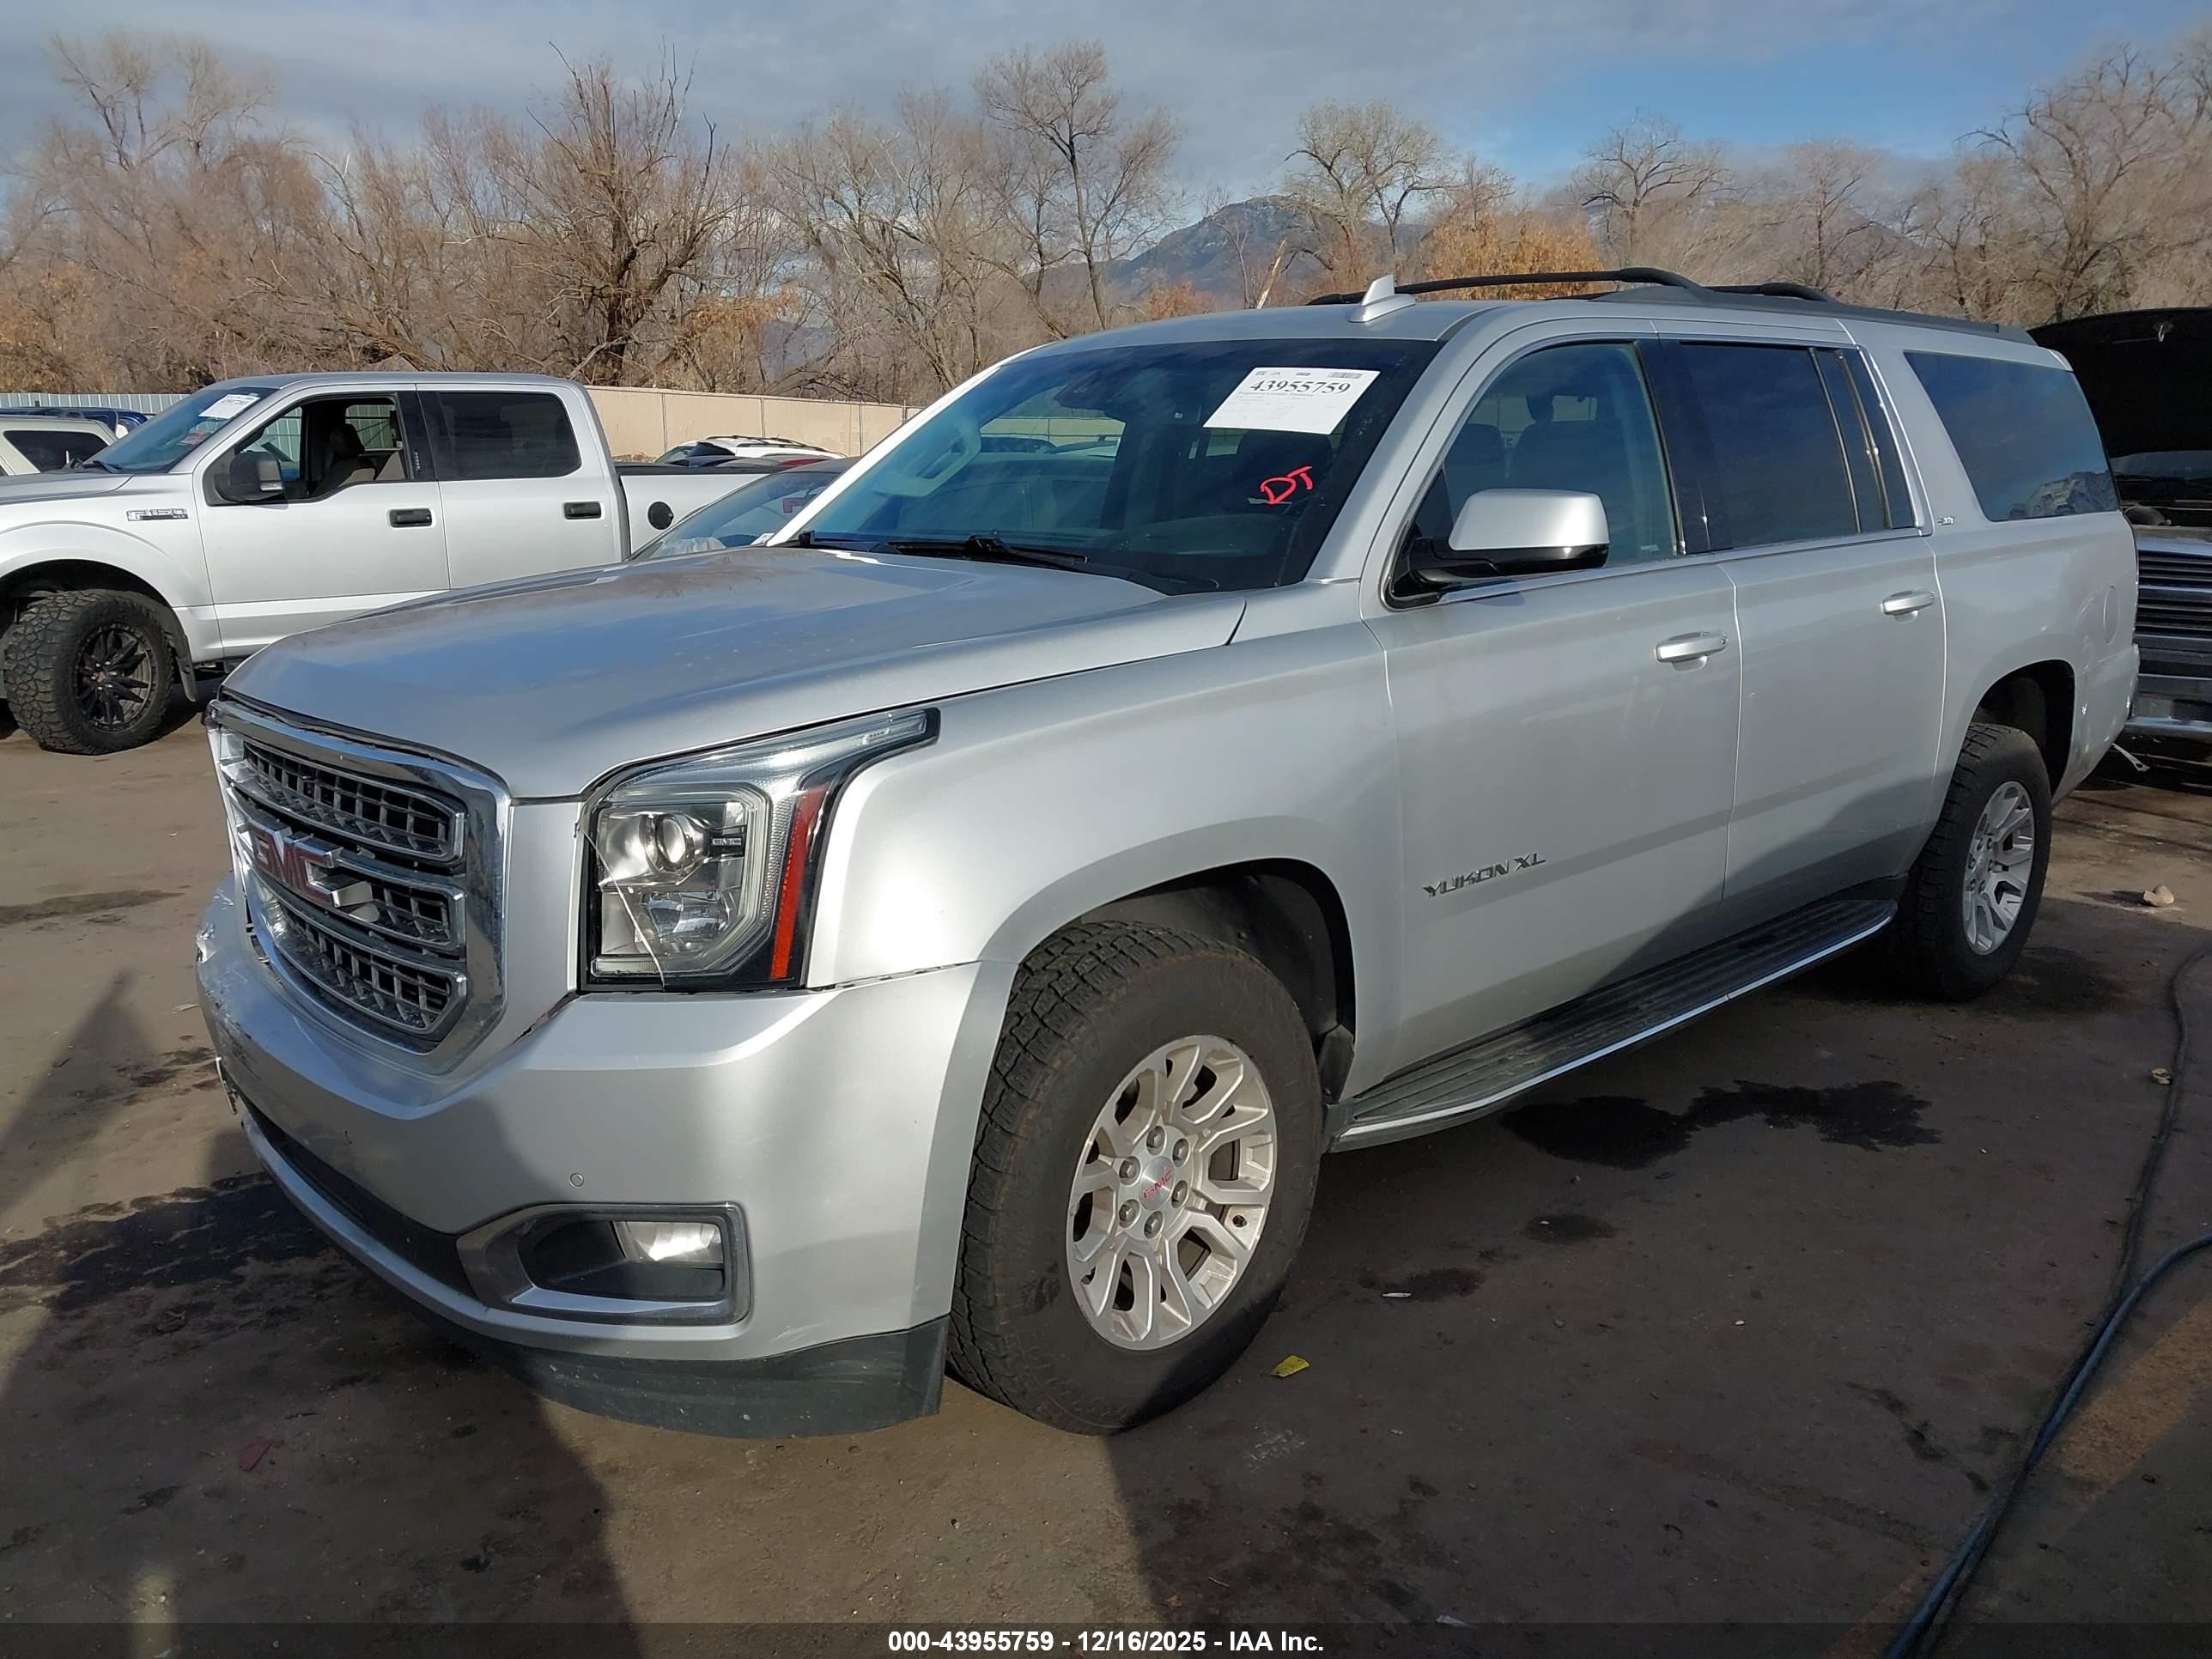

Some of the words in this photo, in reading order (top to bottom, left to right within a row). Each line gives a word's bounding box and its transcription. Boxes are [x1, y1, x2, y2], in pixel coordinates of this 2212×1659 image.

[1249, 380, 1352, 394] 43955759
[245, 820, 345, 908] GMC
[1422, 860, 1510, 898] YUKON
[1514, 853, 1547, 872] XL
[1143, 1169, 1173, 1199] GMC
